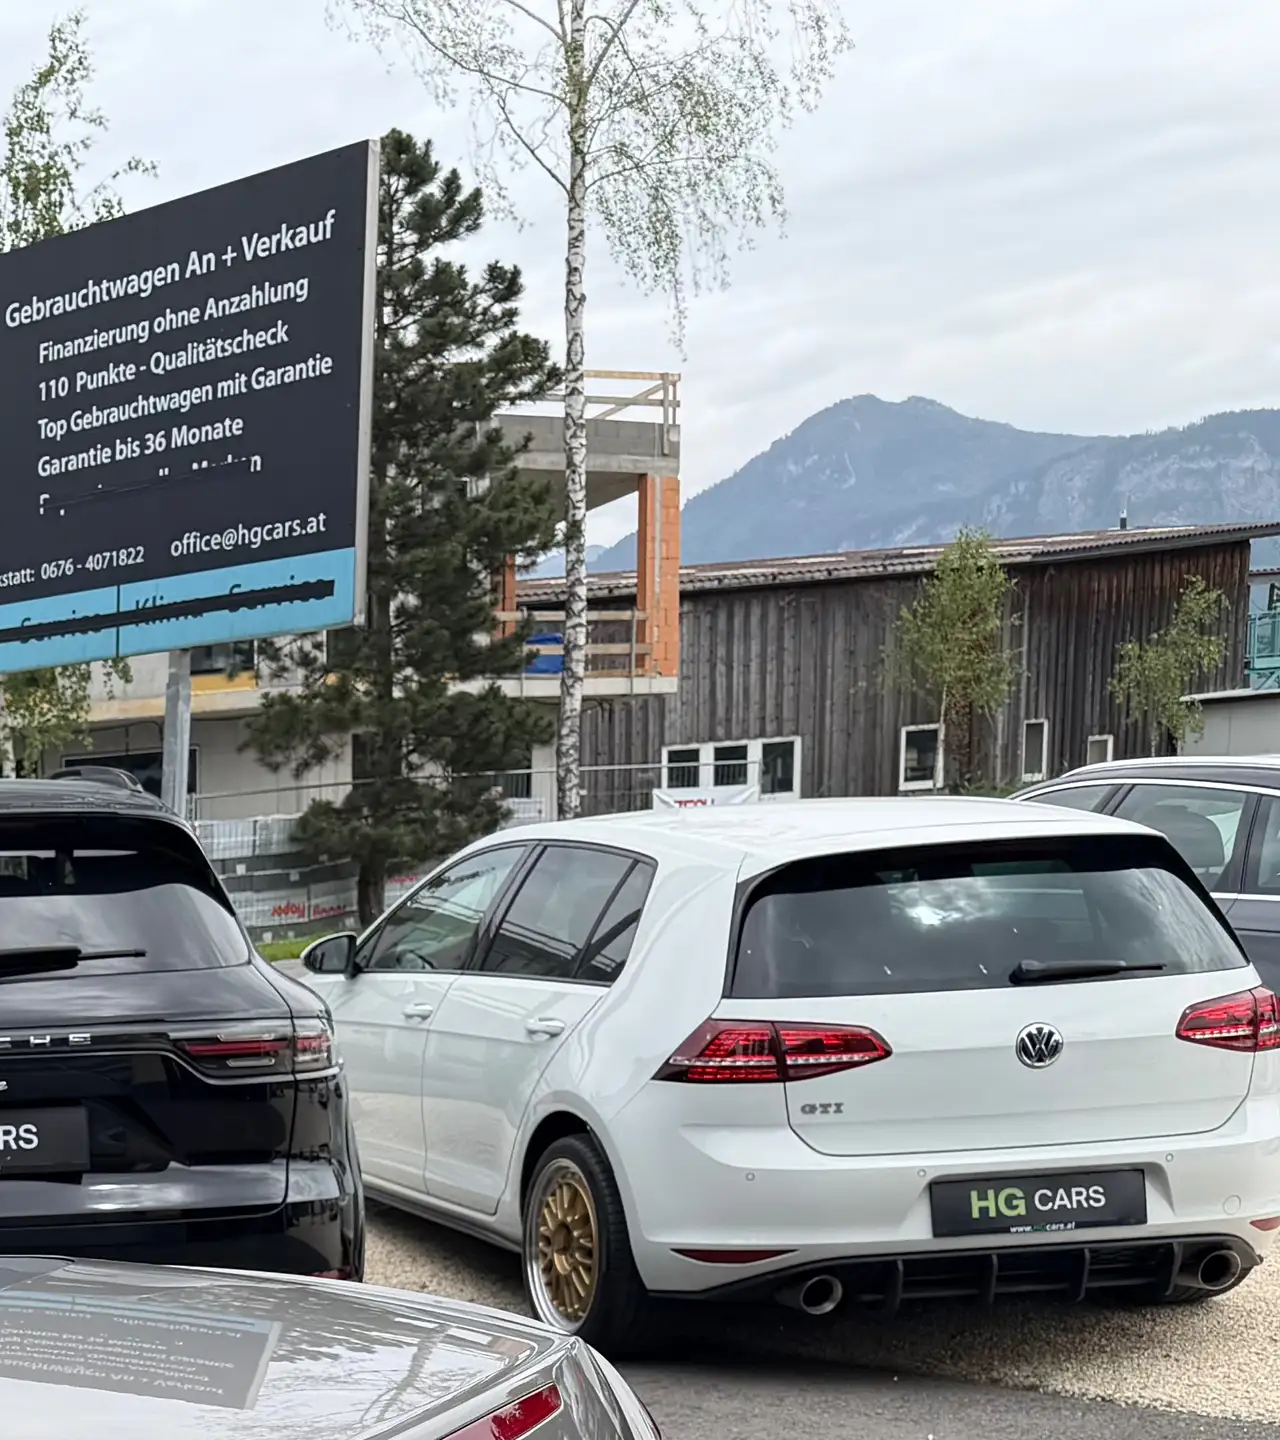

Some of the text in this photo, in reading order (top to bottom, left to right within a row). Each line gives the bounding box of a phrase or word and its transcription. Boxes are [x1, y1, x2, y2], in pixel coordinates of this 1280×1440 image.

[5, 209, 336, 328] Gebrauchtwagen An + Verkauf
[39, 277, 309, 364] Finanzierung ohne Anzahlung
[38, 376, 69, 401] 110
[76, 362, 136, 392] Punkte
[150, 320, 289, 375] Qualitätscheck
[37, 353, 333, 441] Top Gebrauchtwagen mit Garantie
[38, 417, 244, 477] Garantie bis 36 Monate
[41, 558, 74, 580] 0676
[85, 546, 145, 572] 4071822
[170, 512, 327, 557] office@hgcars.at
[800, 1102, 845, 1115] GTI
[970, 1185, 1107, 1220] HG CARS
